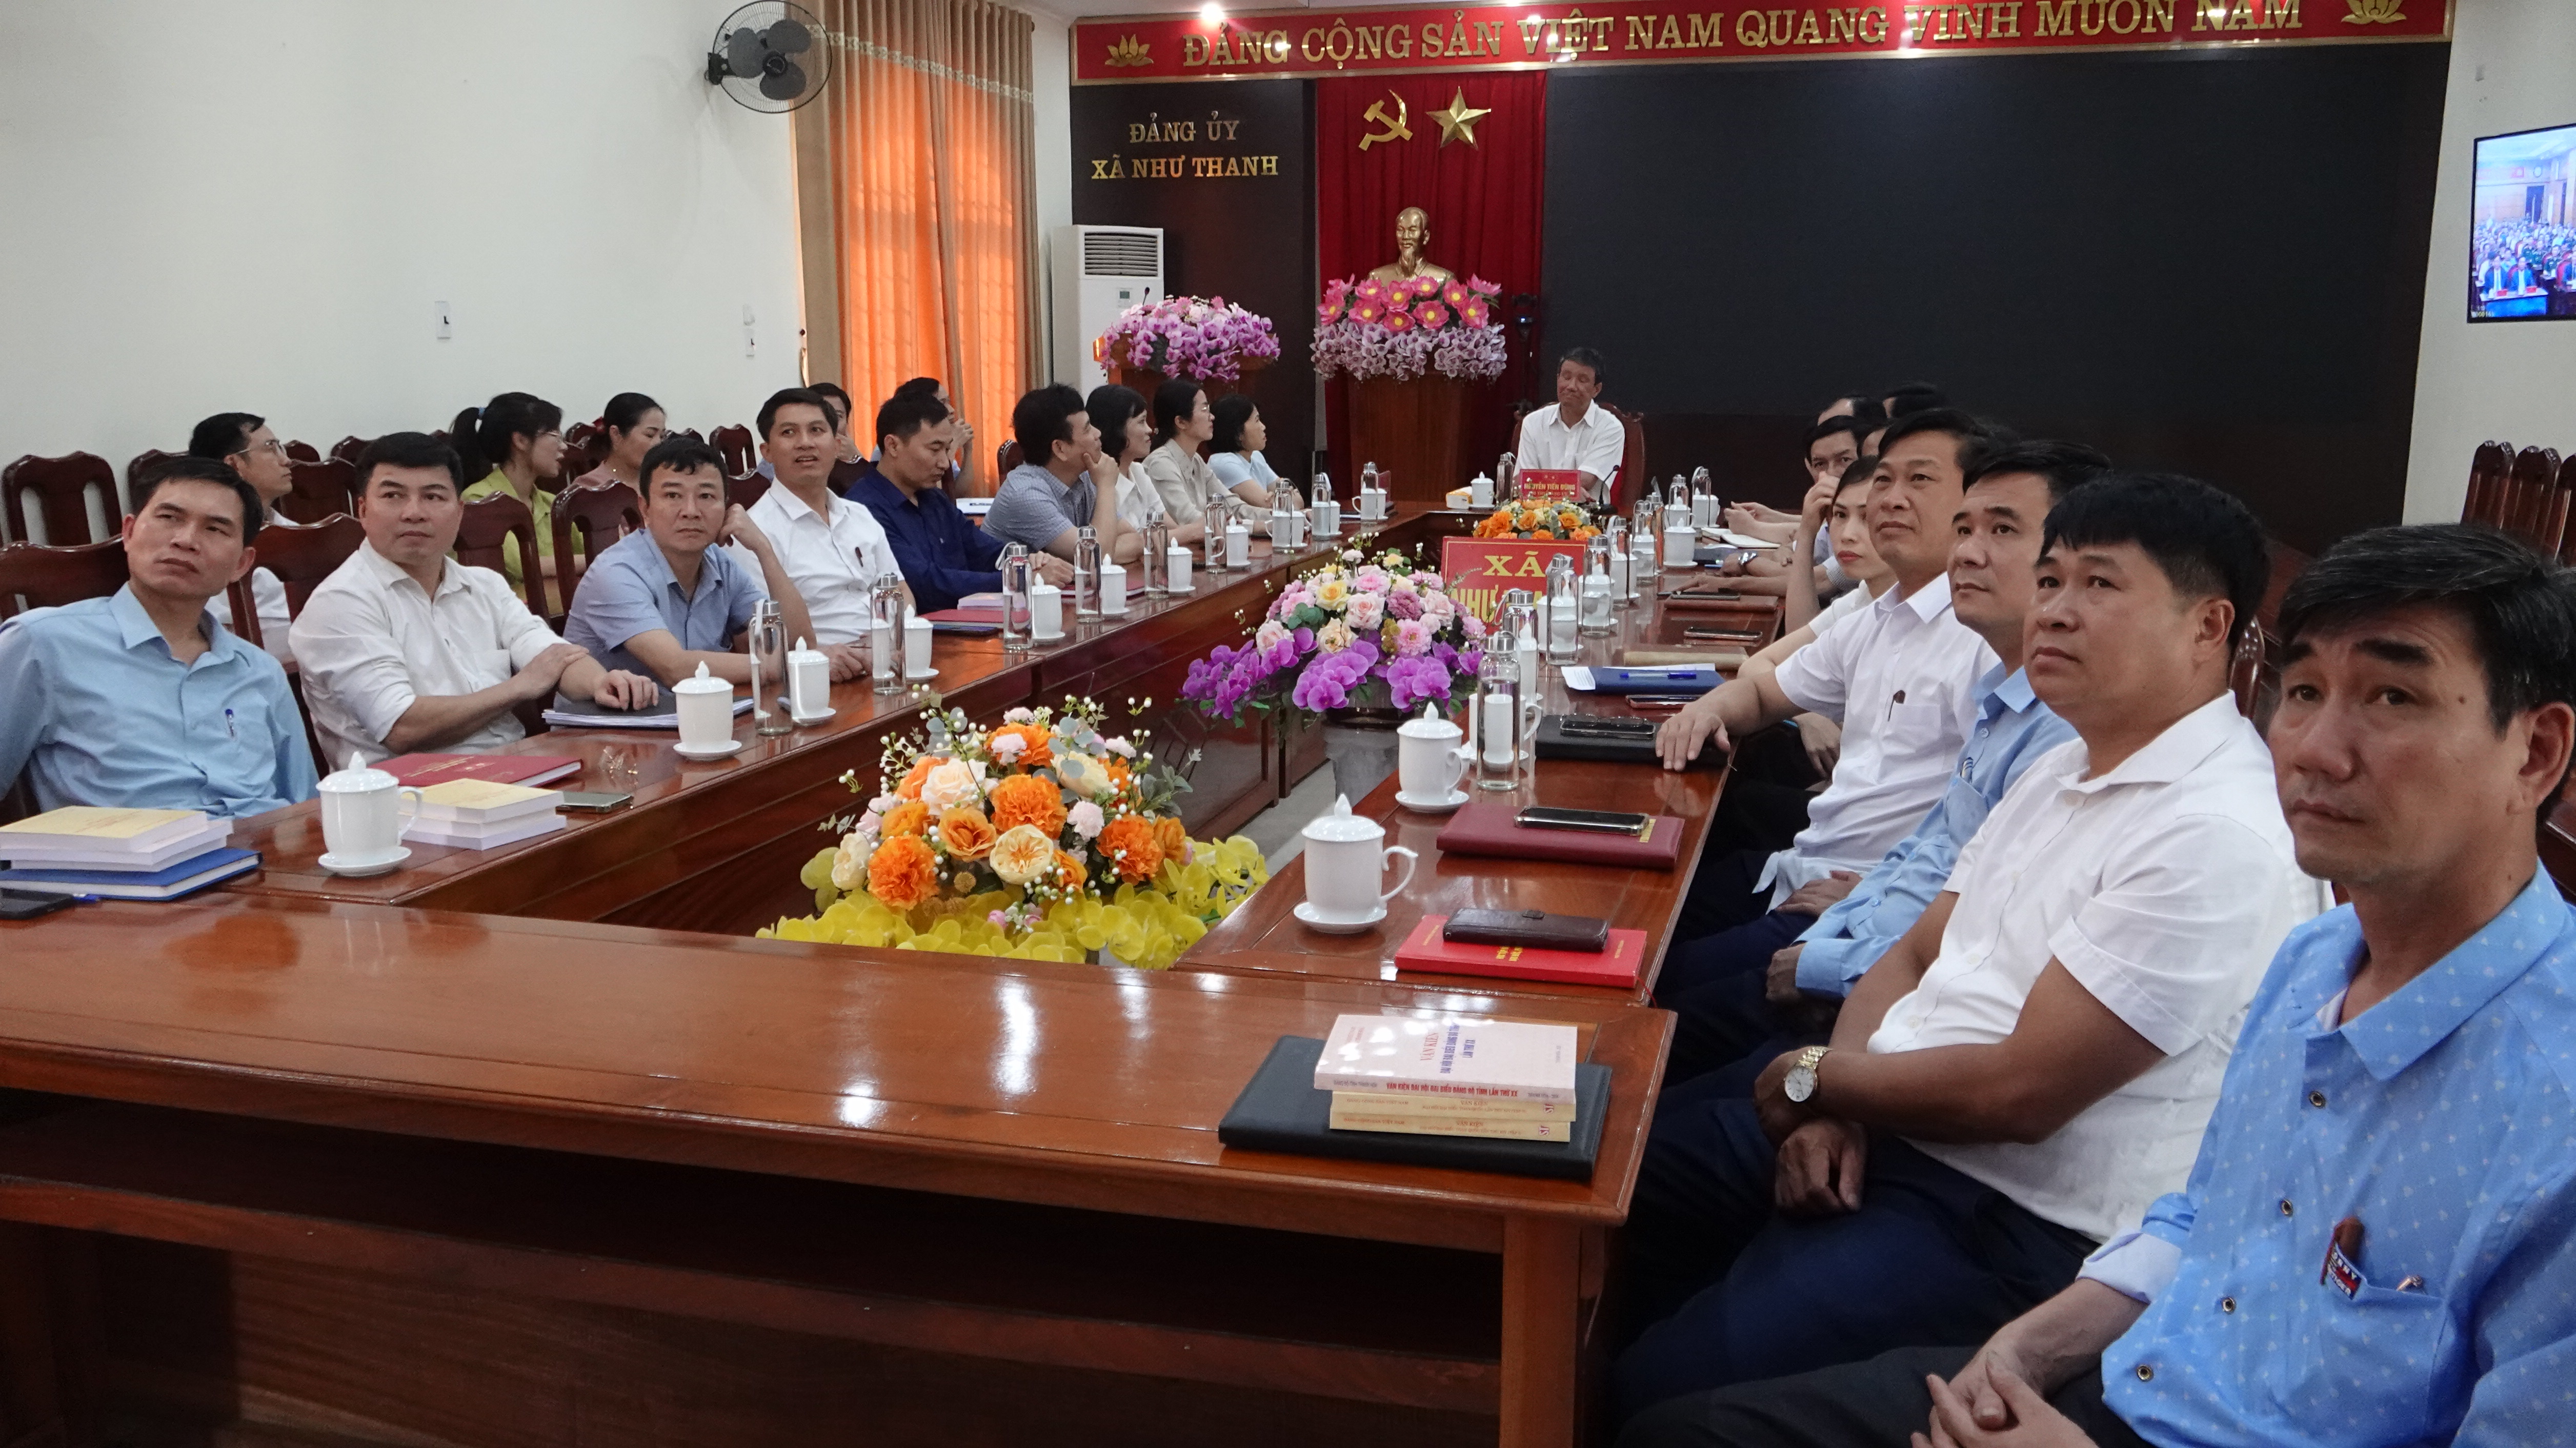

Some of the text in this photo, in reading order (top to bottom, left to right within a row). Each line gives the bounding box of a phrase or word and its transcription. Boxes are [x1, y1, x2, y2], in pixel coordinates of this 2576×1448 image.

[1183, 22, 1291, 66] ĐẢNG
[1302, 17, 1413, 70] CỘNG
[1422, 10, 1504, 57] SẢN
[1517, 8, 1614, 61] VIỆT
[1625, 13, 1724, 50] NAM
[1736, 6, 1889, 48] QUANG
[1903, 2, 2023, 42] VINH
[1130, 110, 1240, 143] ĐẢNG ỦY
[1091, 154, 1279, 179] XÃ NHƯ THANH
[1483, 551, 1546, 577] XÃ
